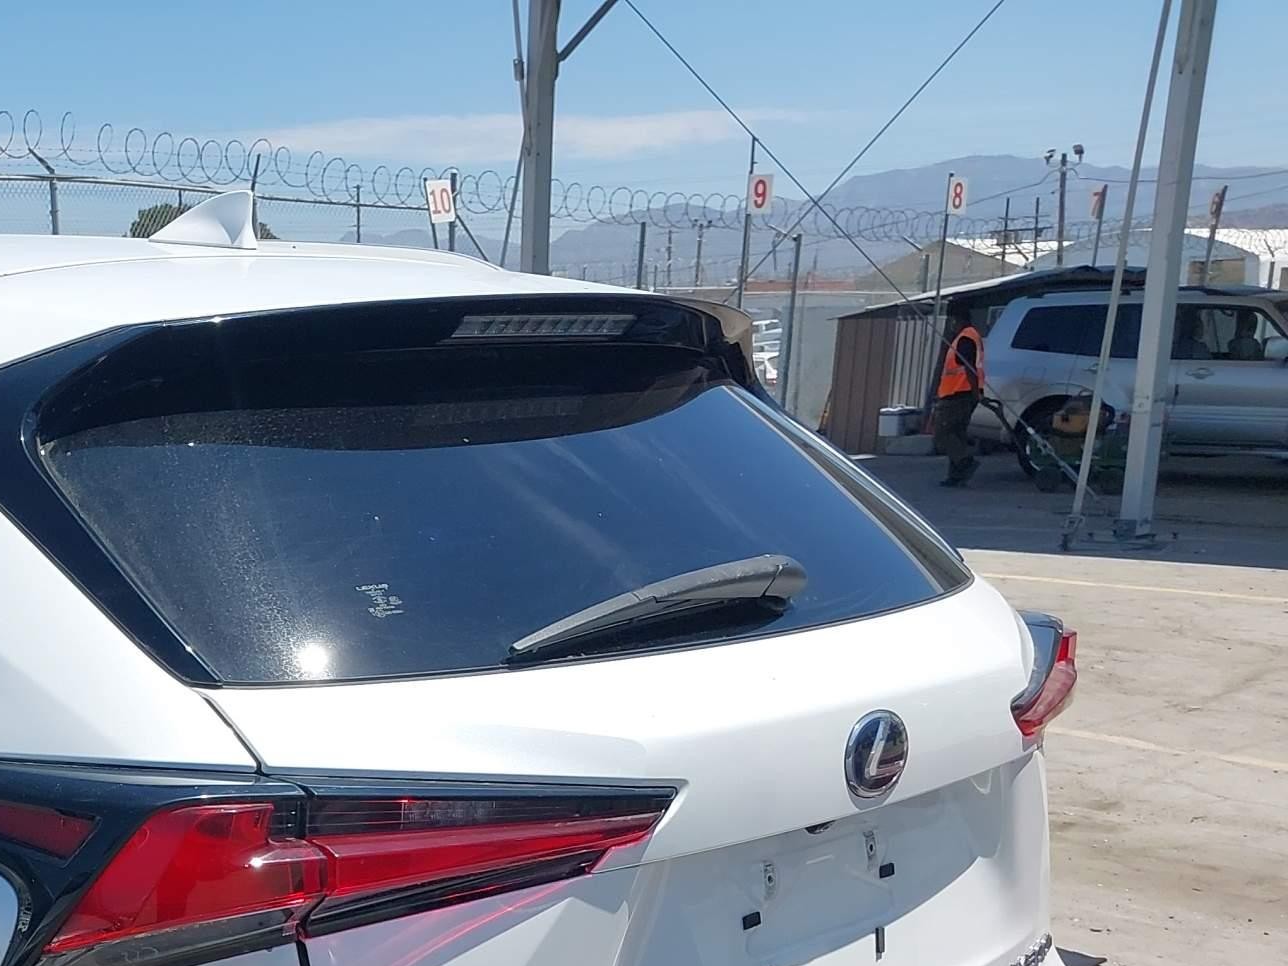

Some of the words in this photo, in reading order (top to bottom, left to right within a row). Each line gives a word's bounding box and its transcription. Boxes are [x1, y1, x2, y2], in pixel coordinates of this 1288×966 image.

[429, 188, 451, 214] 10
[754, 179, 767, 208] 9
[952, 182, 963, 209] 8
